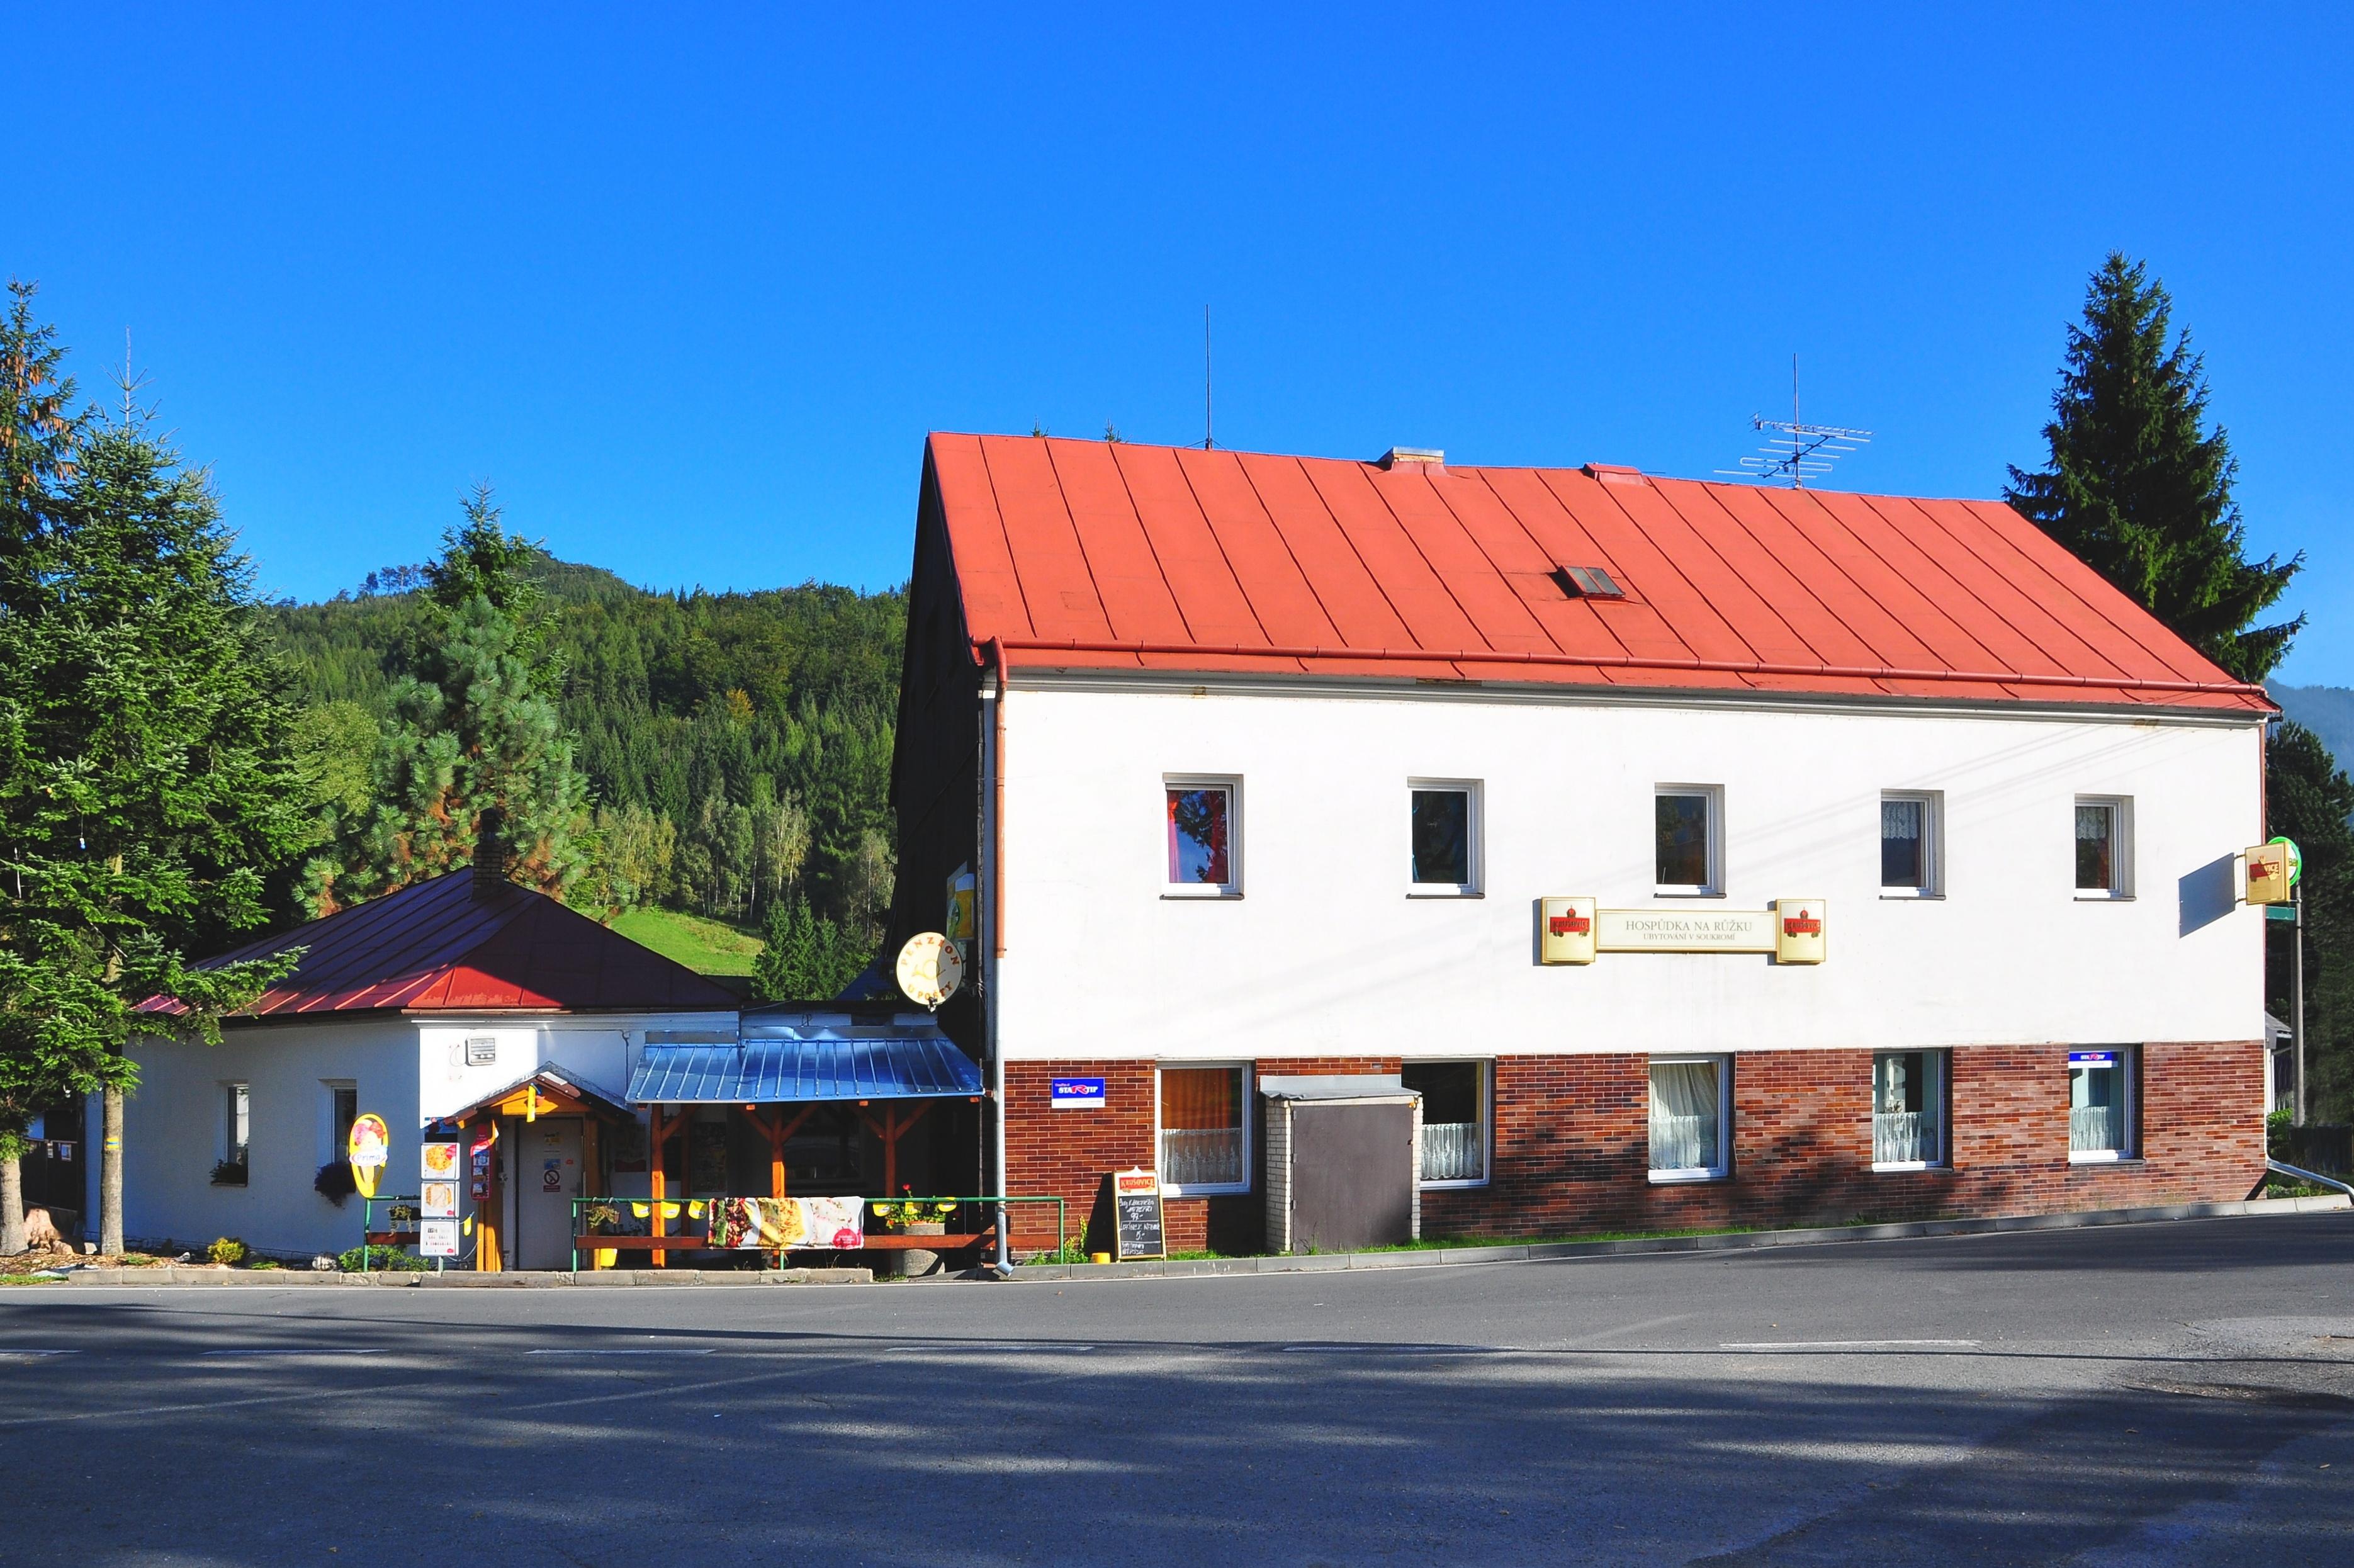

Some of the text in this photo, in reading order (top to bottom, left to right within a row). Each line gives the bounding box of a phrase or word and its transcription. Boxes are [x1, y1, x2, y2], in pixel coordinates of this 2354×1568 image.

[1626, 918, 1753, 932] HOSPŮDKA NA RŮŽKU
[1696, 933, 1735, 941] SOUKROMÍ
[901, 937, 960, 966] PENZION
[908, 984, 915, 993] U
[1120, 1177, 1154, 1188] KRUŠOVICE
